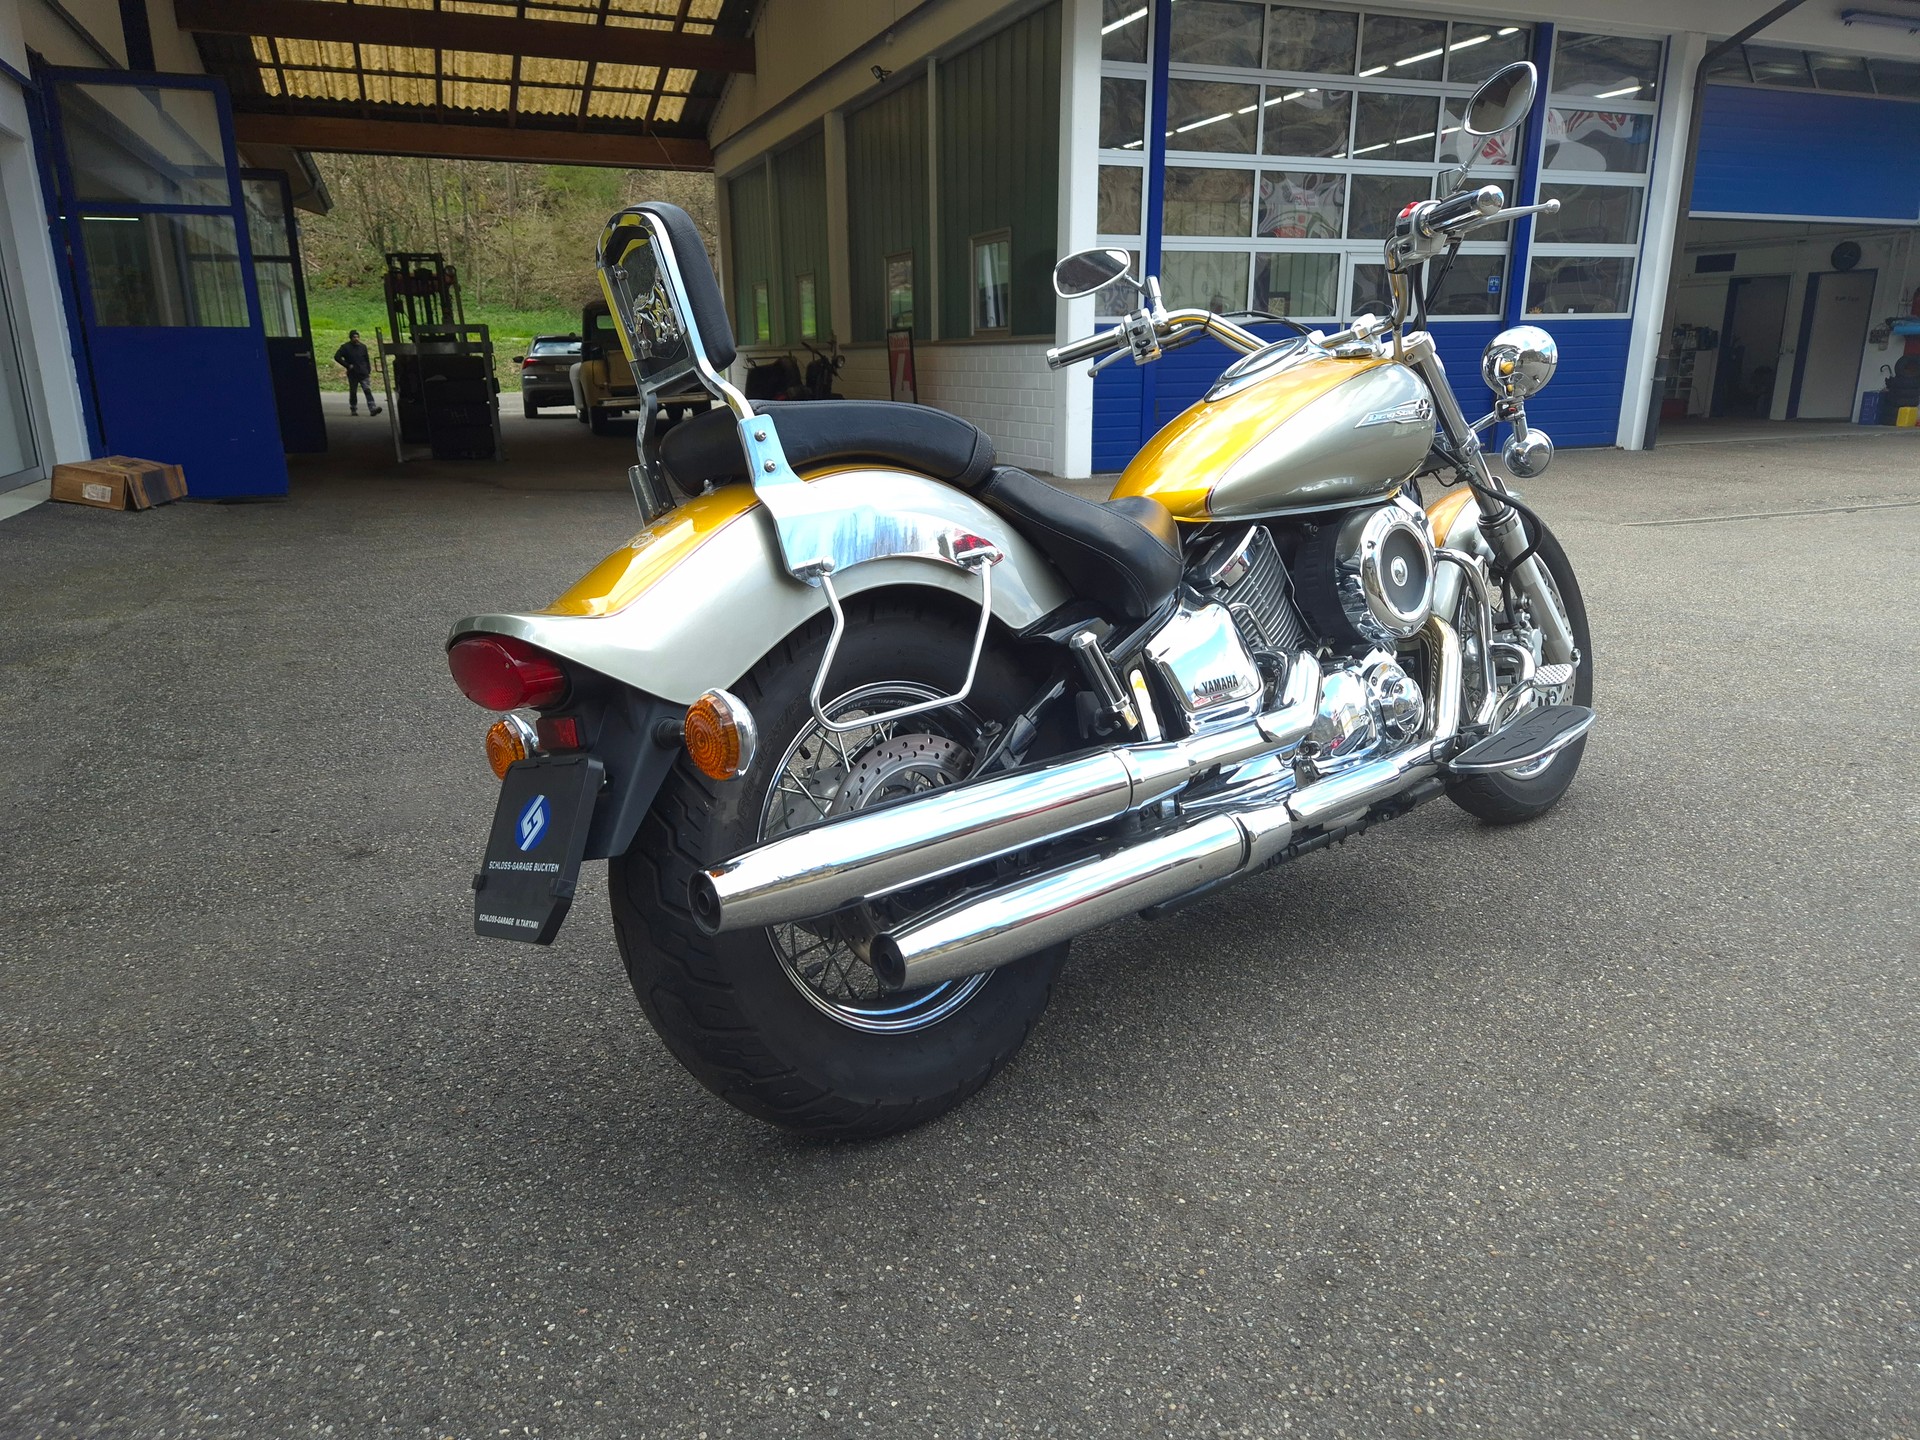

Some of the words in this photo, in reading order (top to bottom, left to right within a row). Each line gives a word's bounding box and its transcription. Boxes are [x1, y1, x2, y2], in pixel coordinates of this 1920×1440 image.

[1202, 675, 1239, 693] YAMAHA
[489, 861, 533, 871] SCHLOSS-GARAGE
[533, 863, 560, 872] BUCKTEN
[479, 914, 514, 925] SCHLOSS-GARAGE
